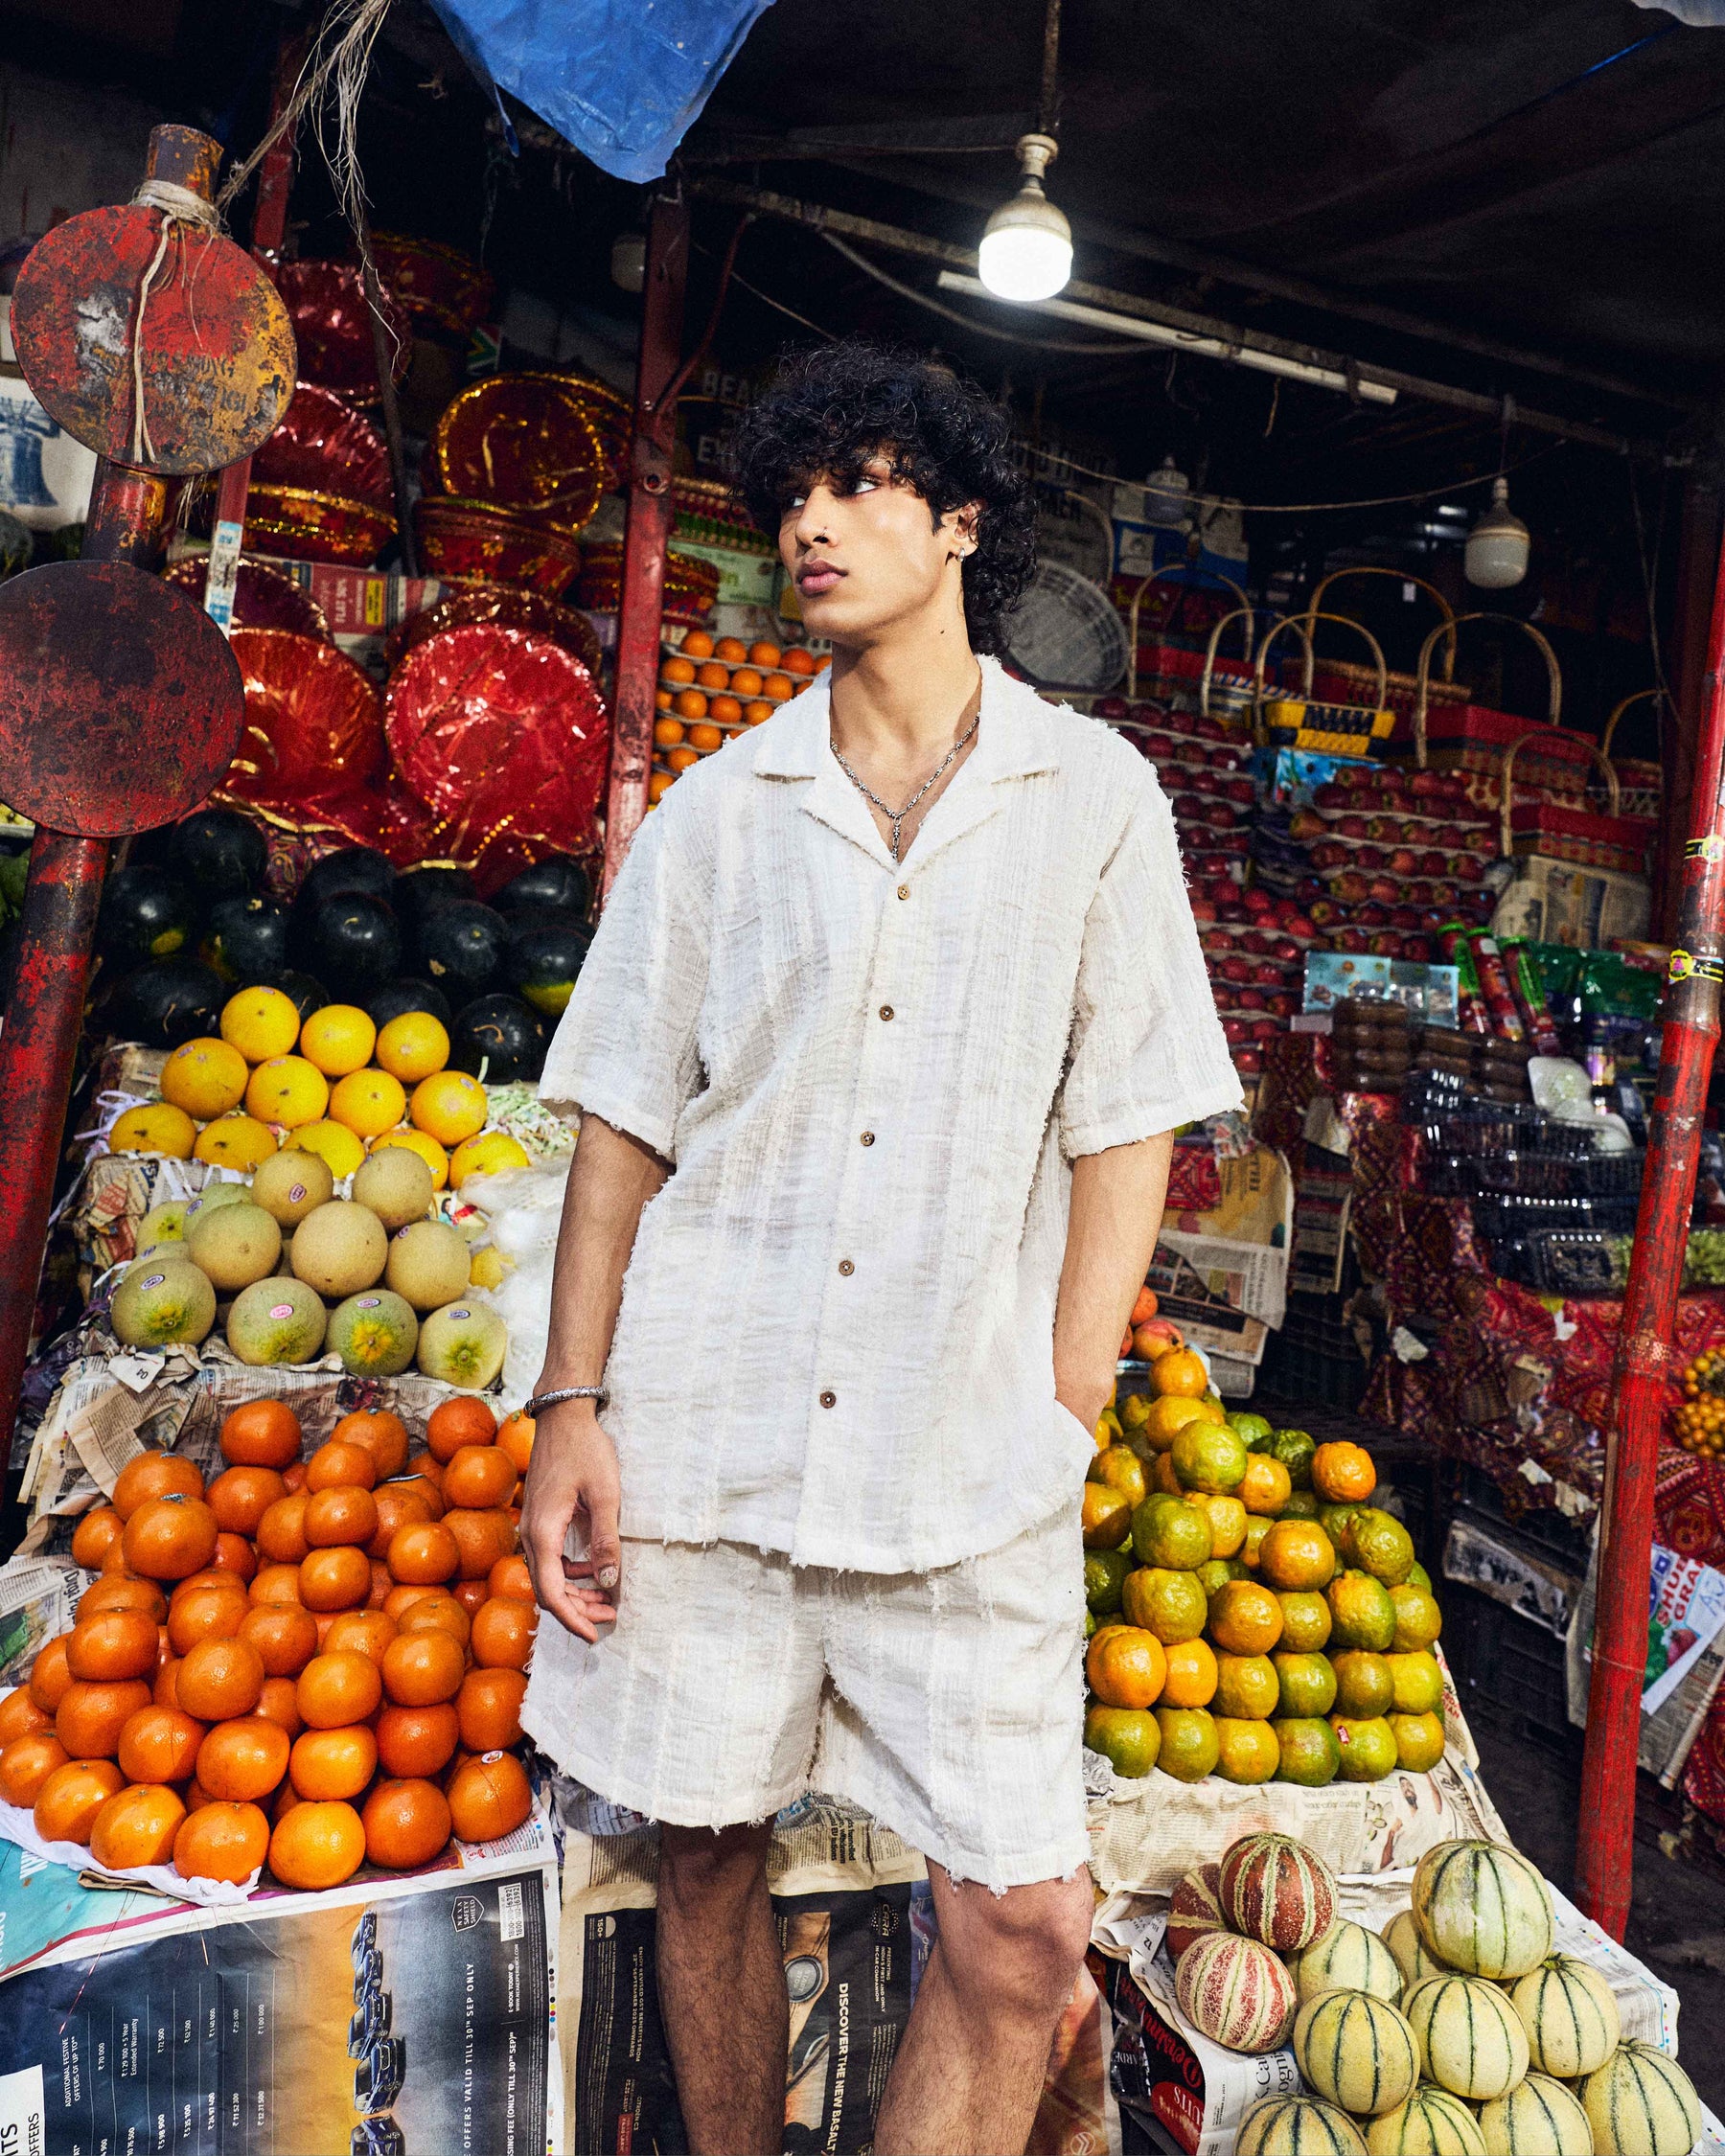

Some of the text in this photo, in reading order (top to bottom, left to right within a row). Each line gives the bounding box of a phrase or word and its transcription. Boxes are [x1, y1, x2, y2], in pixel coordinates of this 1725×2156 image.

[882, 1903, 890, 1937] CARA
[466, 1963, 474, 1992] ONLY
[466, 1997, 474, 2017] SEP
[130, 2018, 139, 2047] Warranty
[465, 2042, 473, 2064] TILL
[826, 1983, 849, 2152] DISCOVER THE NEW BASALT
[1114, 2051, 1142, 2065] ARDE
[61, 2037, 72, 2107] ADDITIONAL FESTIVE
[73, 2074, 81, 2101] OFFERS
[464, 2068, 472, 2102] VALID
[1270, 2051, 1294, 2094] ogni
[507, 2093, 517, 2119] (ONLY
[1174, 2086, 1204, 2125] UITS
[463, 2105, 472, 2148] OFFERS
